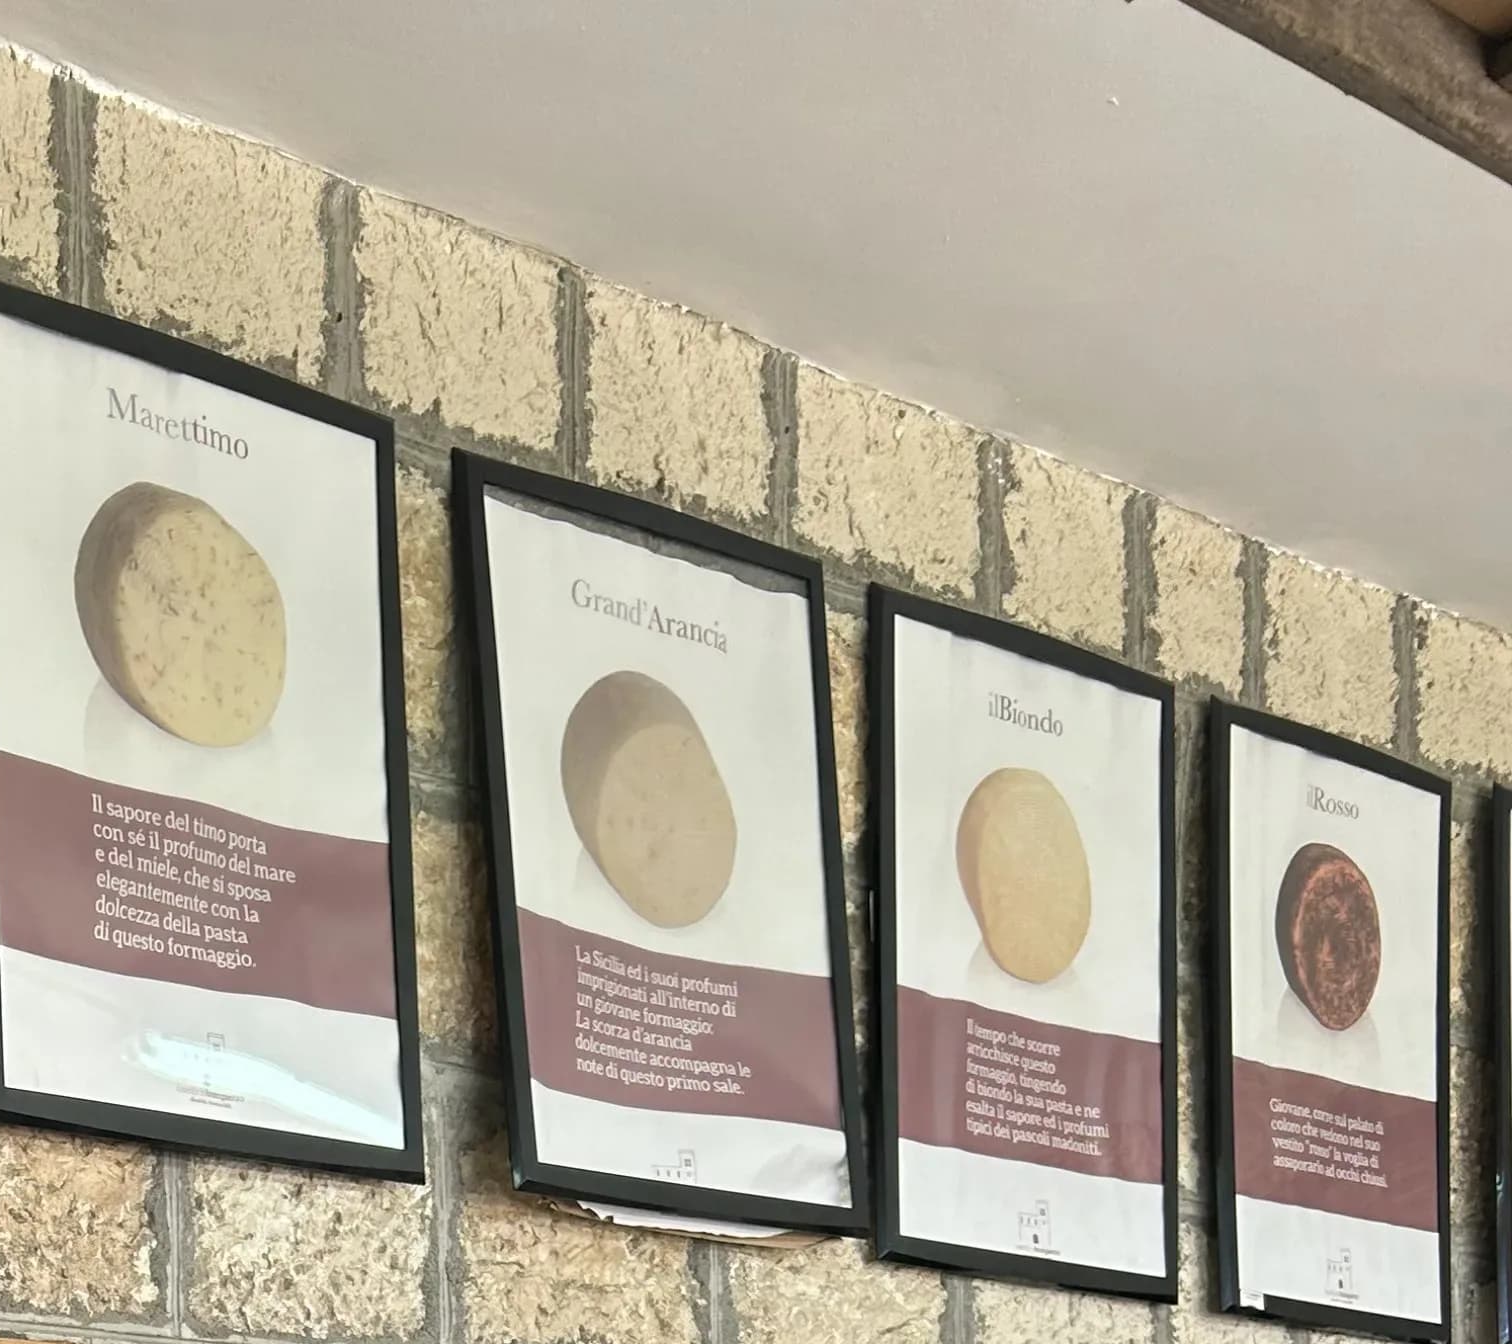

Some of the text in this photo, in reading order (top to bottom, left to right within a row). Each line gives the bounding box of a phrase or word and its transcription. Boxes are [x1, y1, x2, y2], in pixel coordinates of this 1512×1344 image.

[106, 388, 249, 460] Marettimo
[92, 793, 267, 855] Il sapore del timo porta
[93, 823, 296, 883] con sé il profumo del mare
[95, 847, 271, 902] e del miele, che si sposa
[95, 895, 248, 944] dolcezza della pasta
[97, 870, 260, 923] elegantemente con la
[94, 920, 256, 969] di questo formaggio.
[575, 1033, 752, 1078] dolcemente accompagna le
[577, 1057, 745, 1094] note di questo primo sale.
